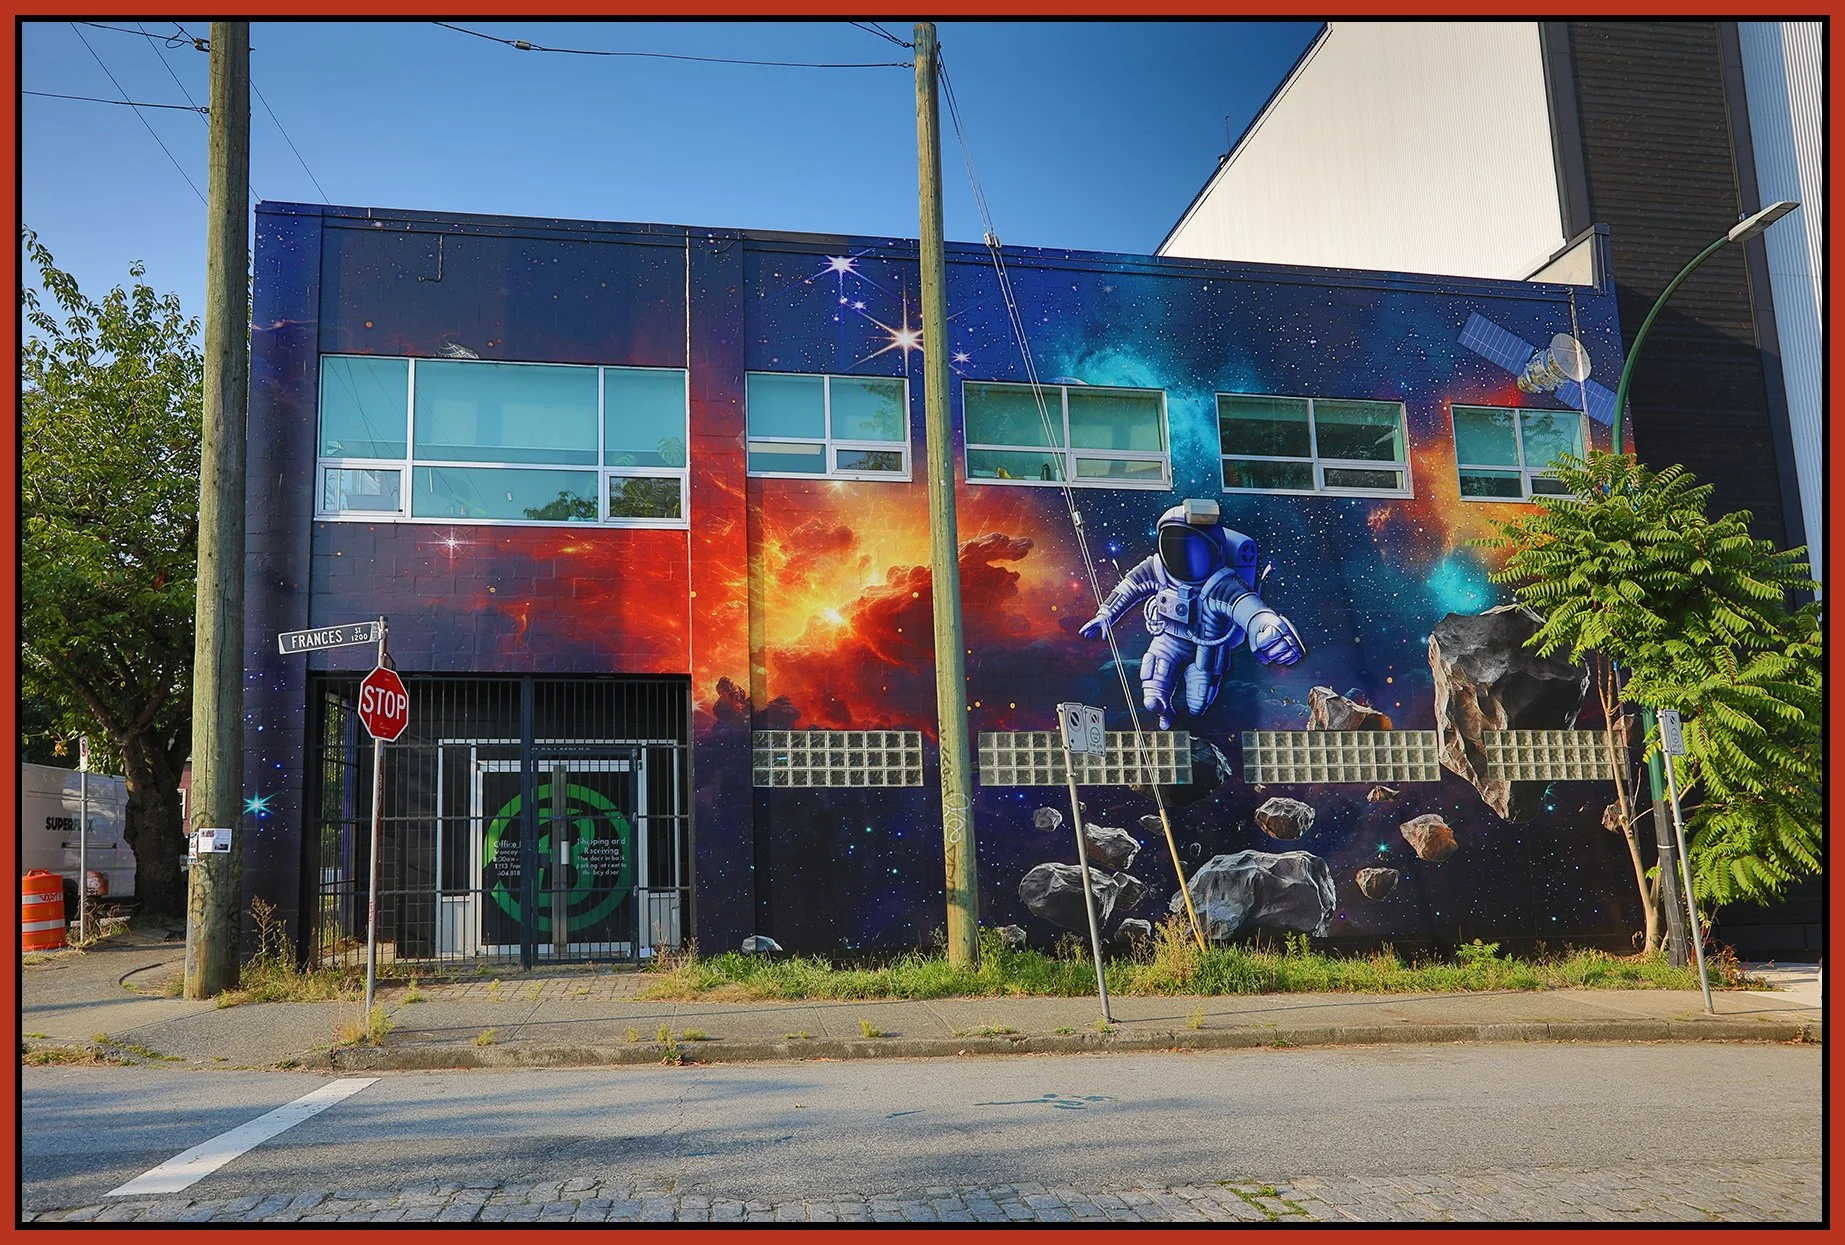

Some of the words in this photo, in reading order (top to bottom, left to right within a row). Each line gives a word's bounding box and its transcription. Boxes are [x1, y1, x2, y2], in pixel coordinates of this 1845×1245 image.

[291, 629, 343, 649] FRANCES
[362, 685, 406, 720] STOP
[45, 816, 93, 832] SUPERFLX
